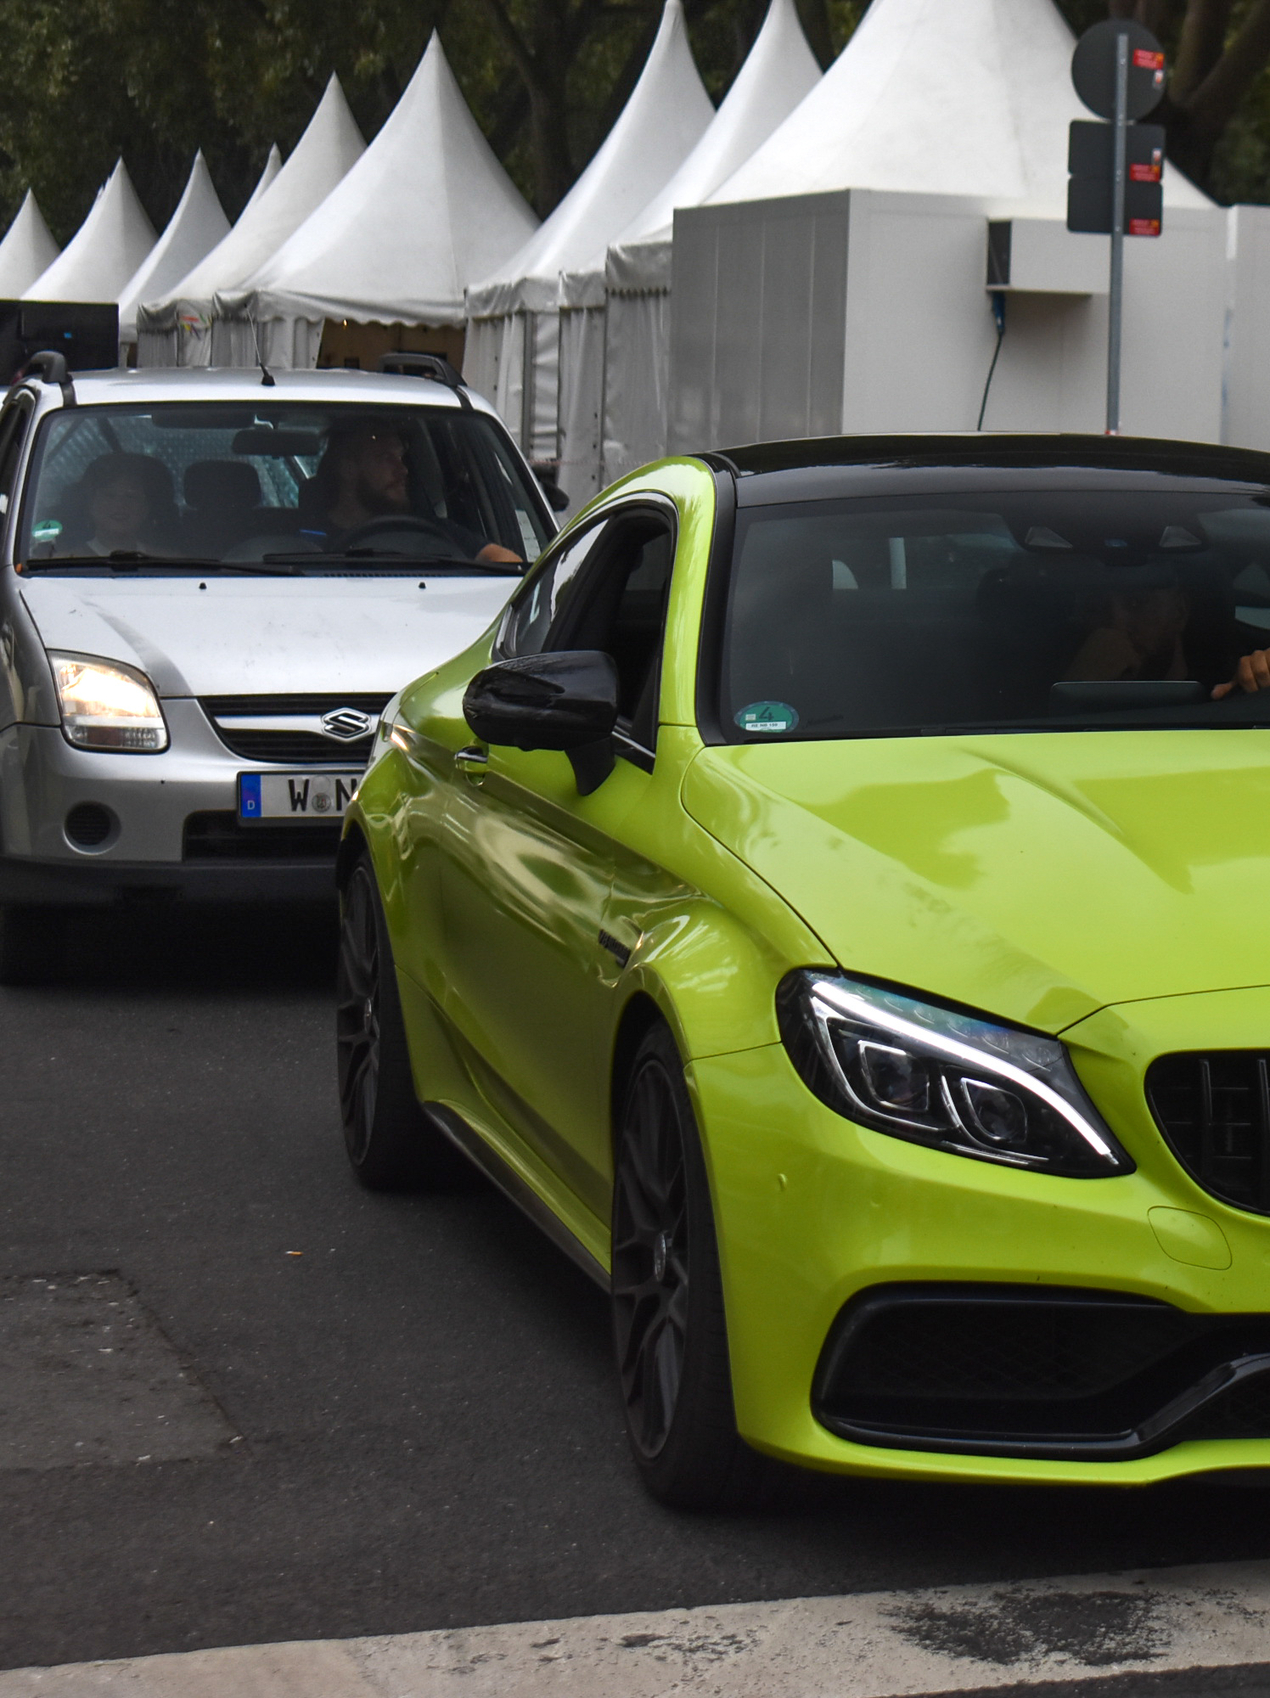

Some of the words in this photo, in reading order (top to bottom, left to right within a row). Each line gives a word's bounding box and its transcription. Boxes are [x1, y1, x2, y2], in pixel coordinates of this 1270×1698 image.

[759, 706, 774, 721] 4
[288, 778, 310, 812] W
[247, 800, 256, 811] D
